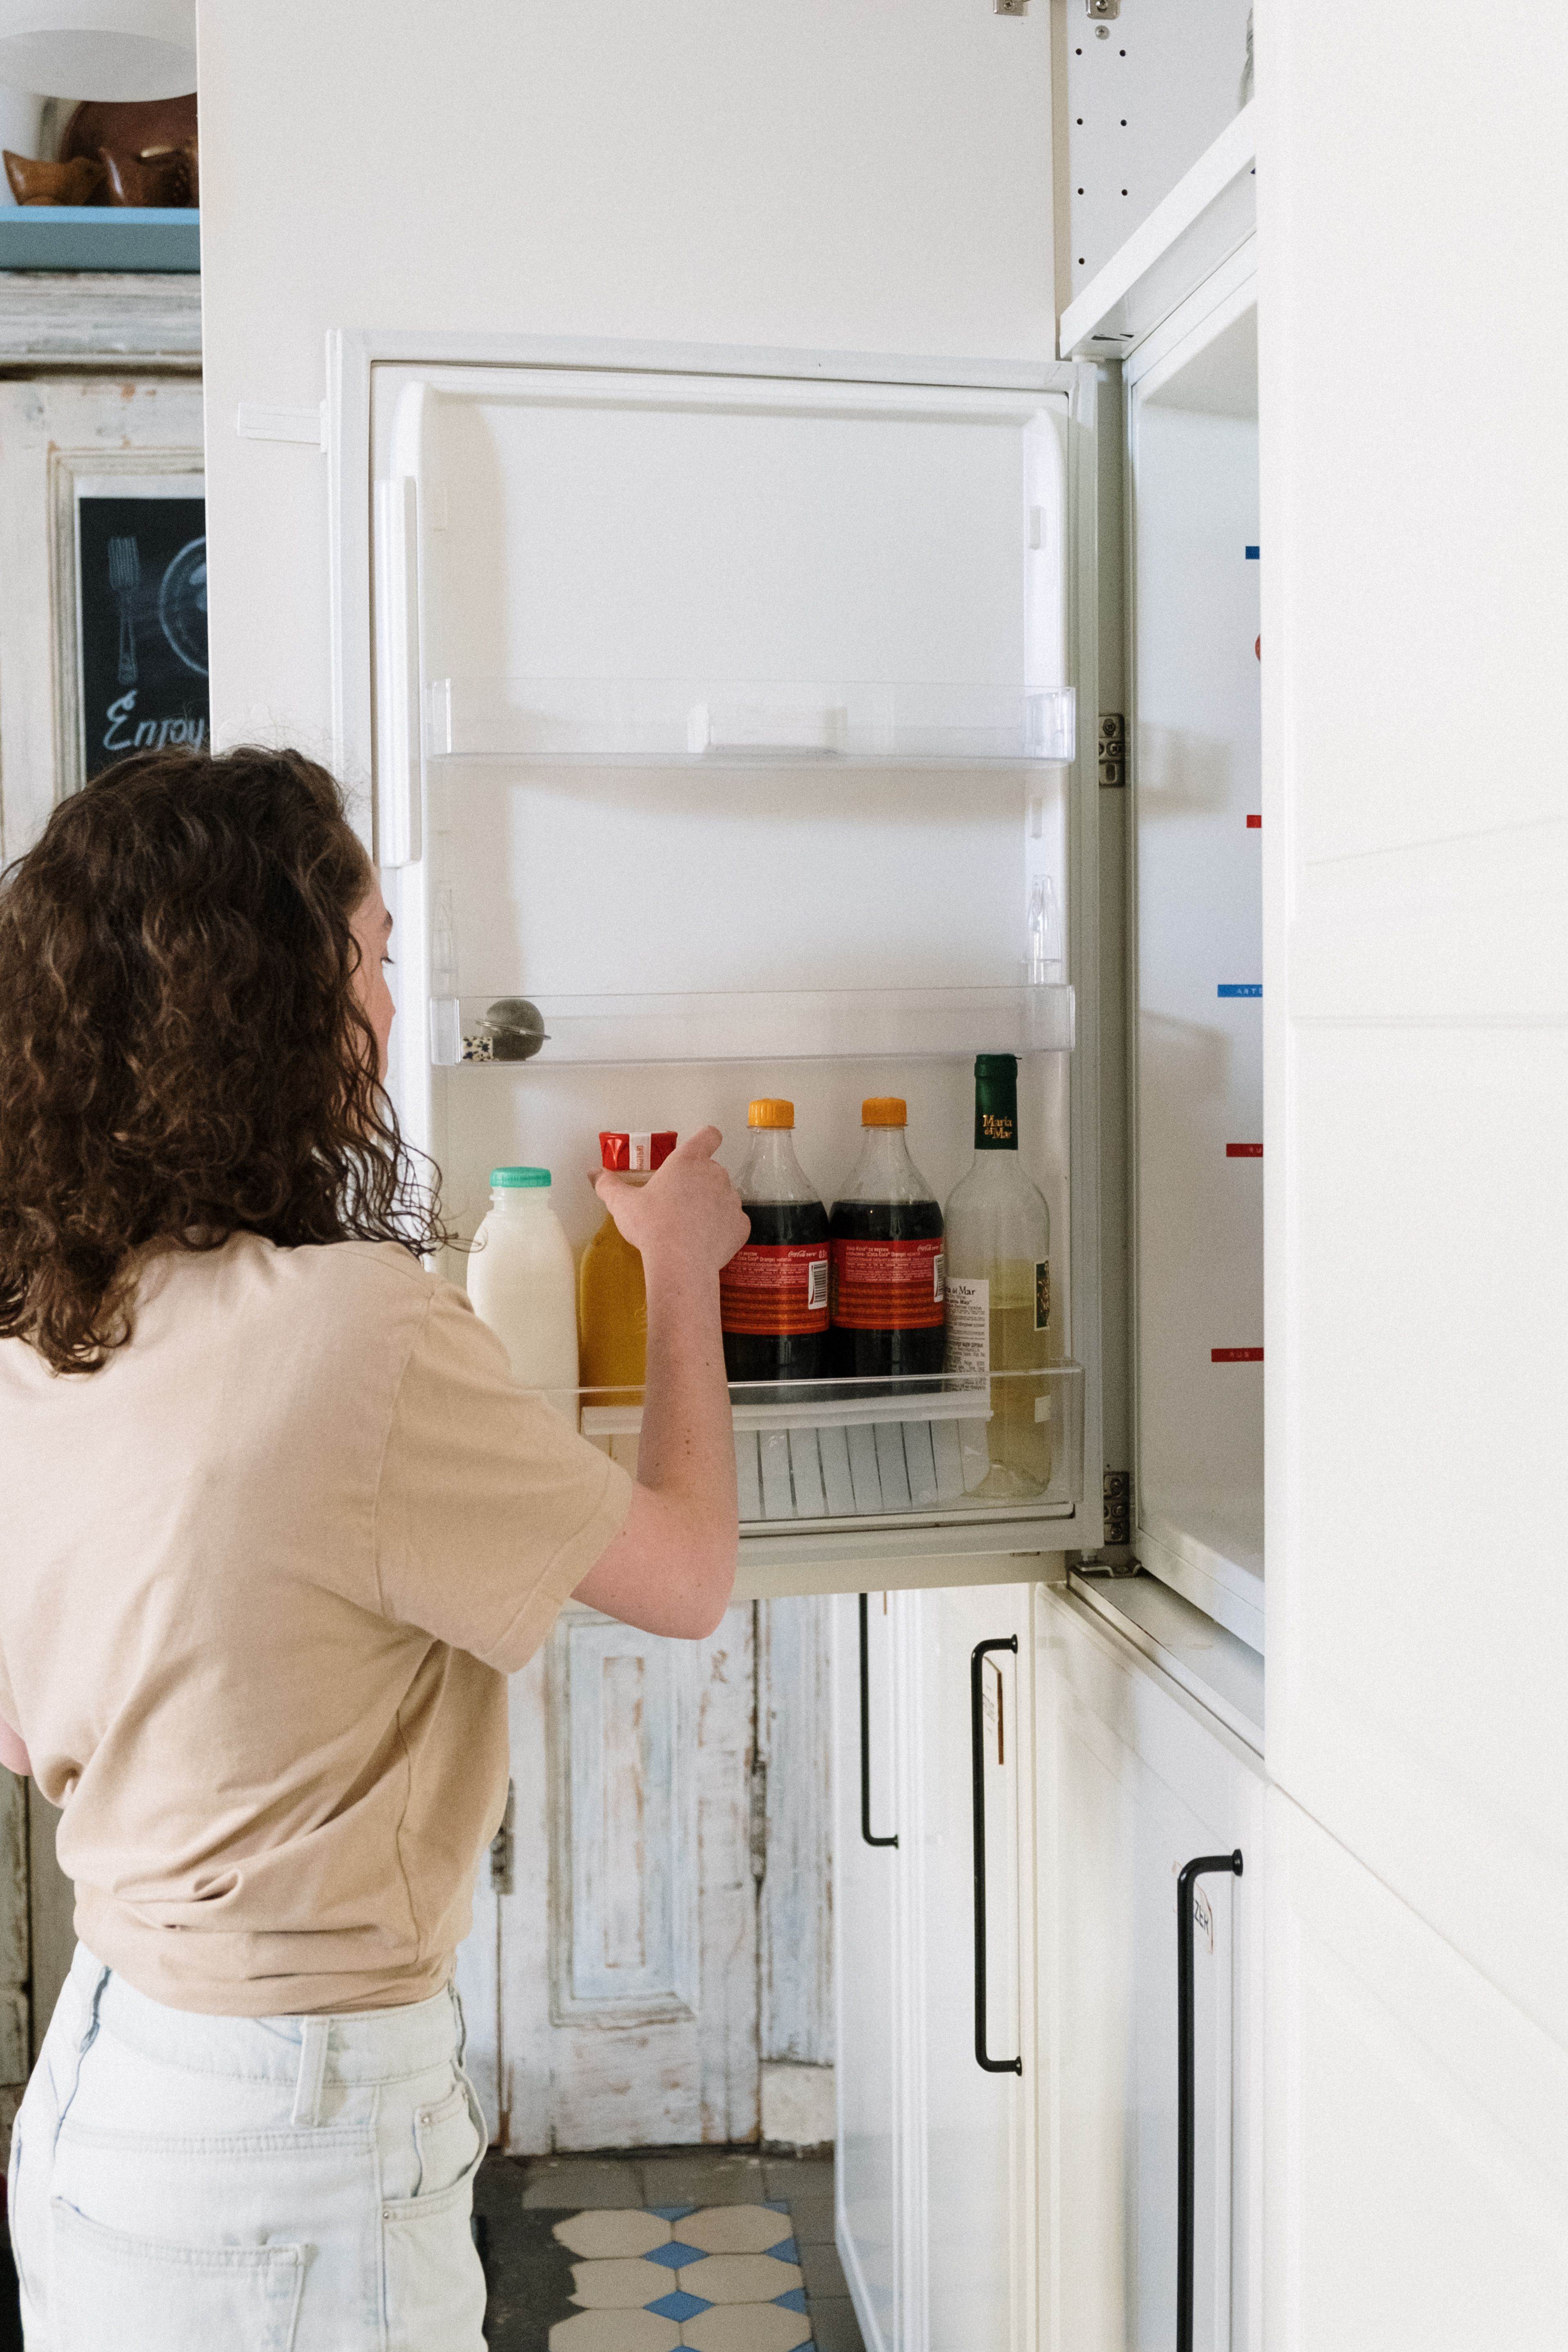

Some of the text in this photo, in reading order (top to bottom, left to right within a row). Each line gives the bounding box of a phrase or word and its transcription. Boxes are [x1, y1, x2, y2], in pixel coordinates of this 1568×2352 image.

[103, 690, 204, 753] Enjoy
[983, 1114, 1012, 1127] Maria
[992, 1127, 1012, 1139] Mar
[959, 1286, 976, 1295] Mar
